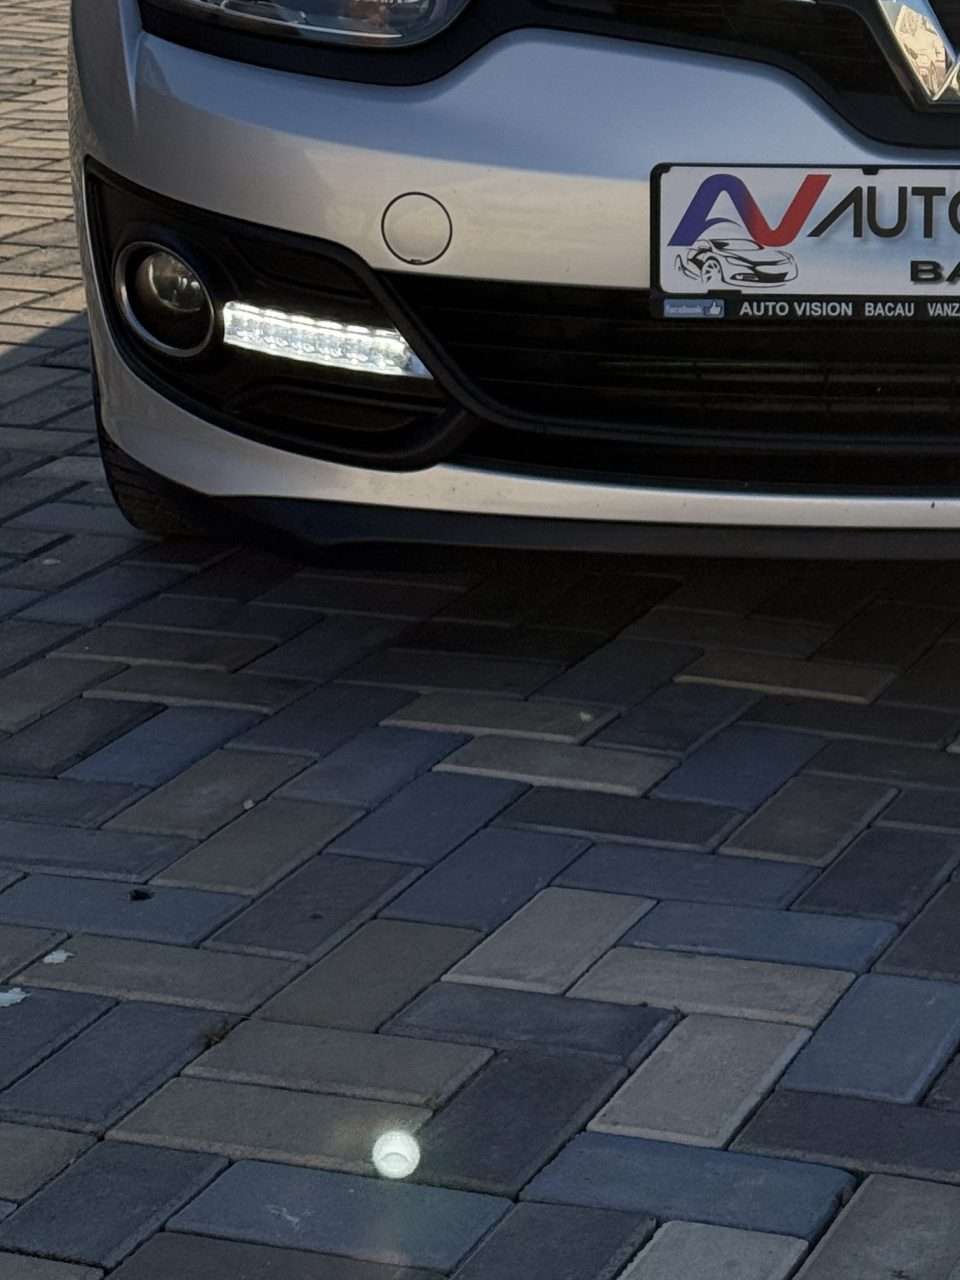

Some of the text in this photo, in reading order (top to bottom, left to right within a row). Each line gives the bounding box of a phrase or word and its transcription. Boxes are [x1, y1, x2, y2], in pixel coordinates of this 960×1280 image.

[739, 301, 790, 317] AUTO
[793, 301, 853, 317] VISION
[864, 302, 915, 317] BACAU
